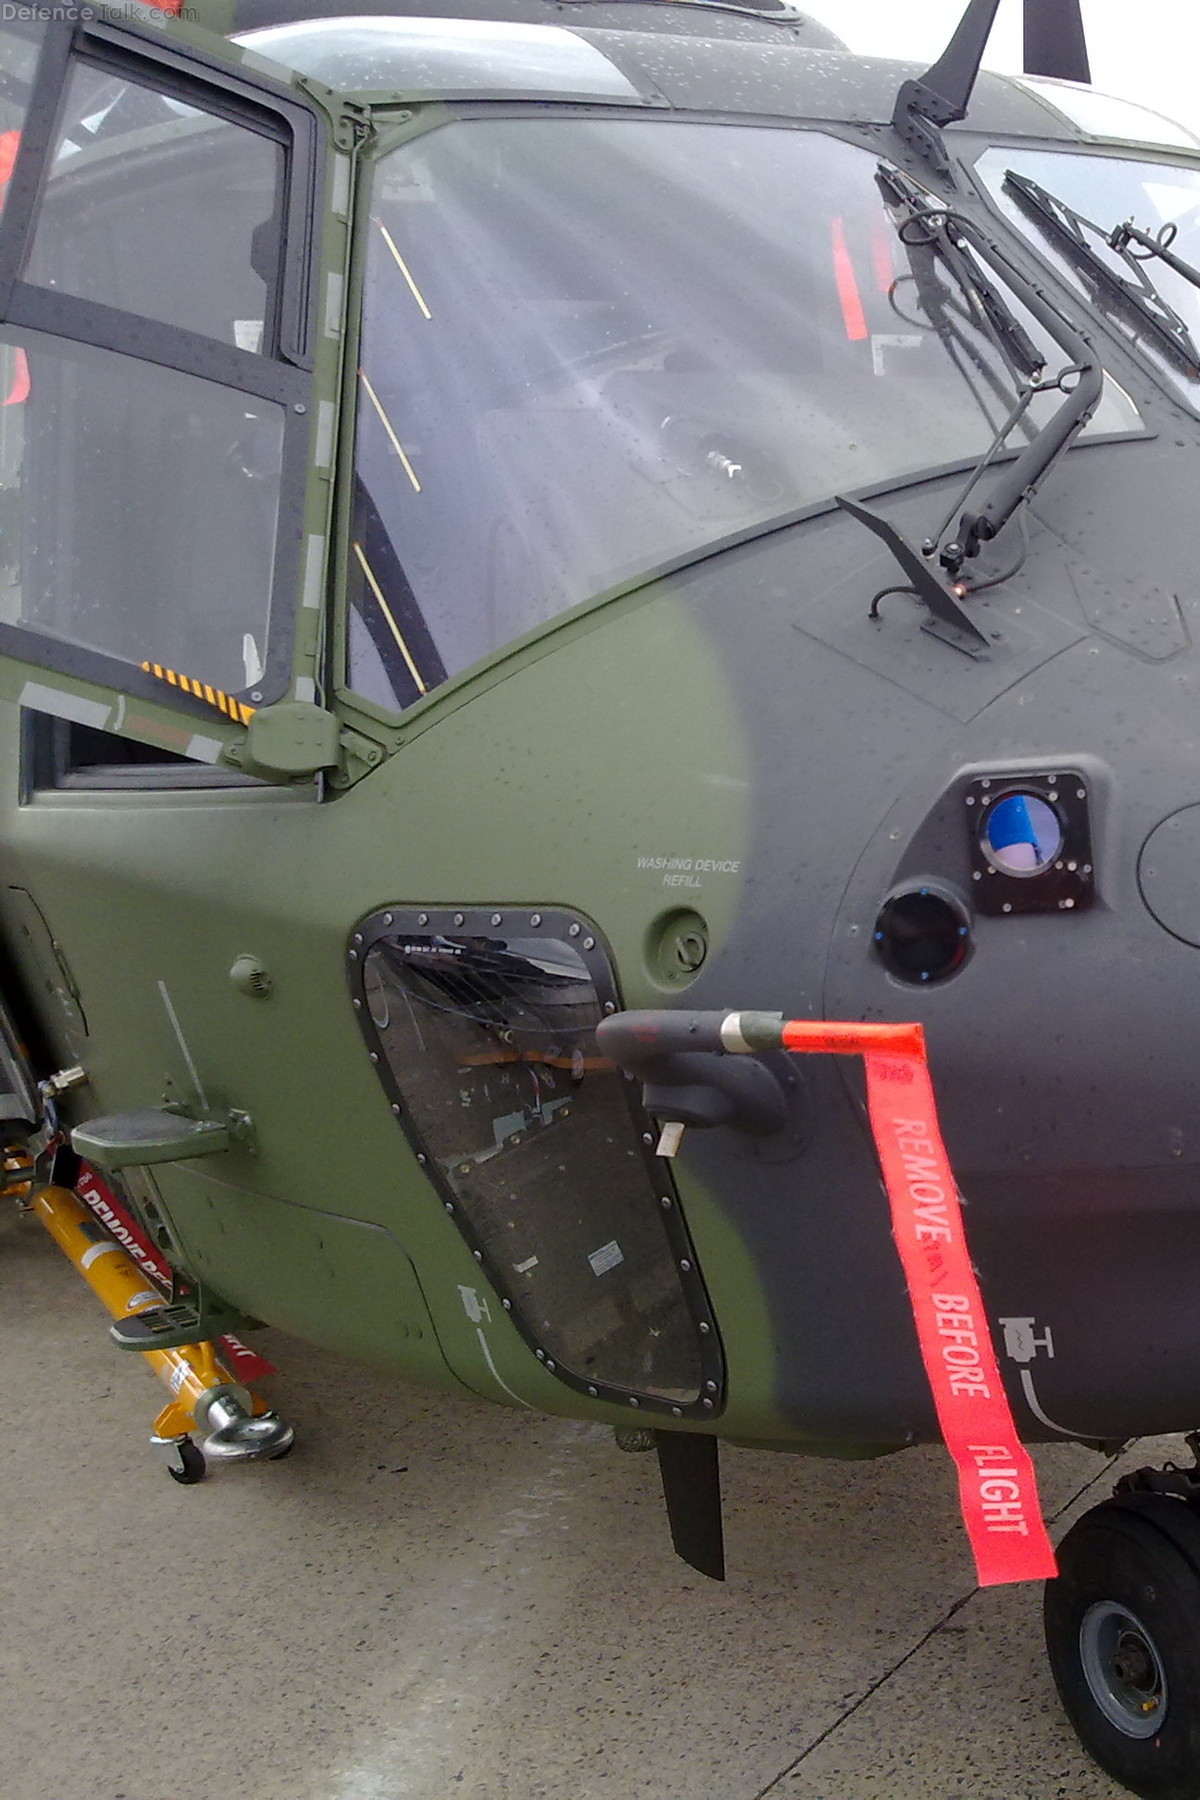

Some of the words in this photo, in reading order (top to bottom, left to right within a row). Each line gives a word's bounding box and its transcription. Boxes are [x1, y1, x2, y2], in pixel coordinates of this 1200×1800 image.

[637, 858, 692, 870] WASHING
[695, 860, 740, 872] DEVICE
[663, 875, 702, 887] REFILL
[891, 1117, 953, 1244] REMOVE
[930, 1293, 991, 1400] BEFORE
[968, 1445, 1028, 1536] FLIGHT
